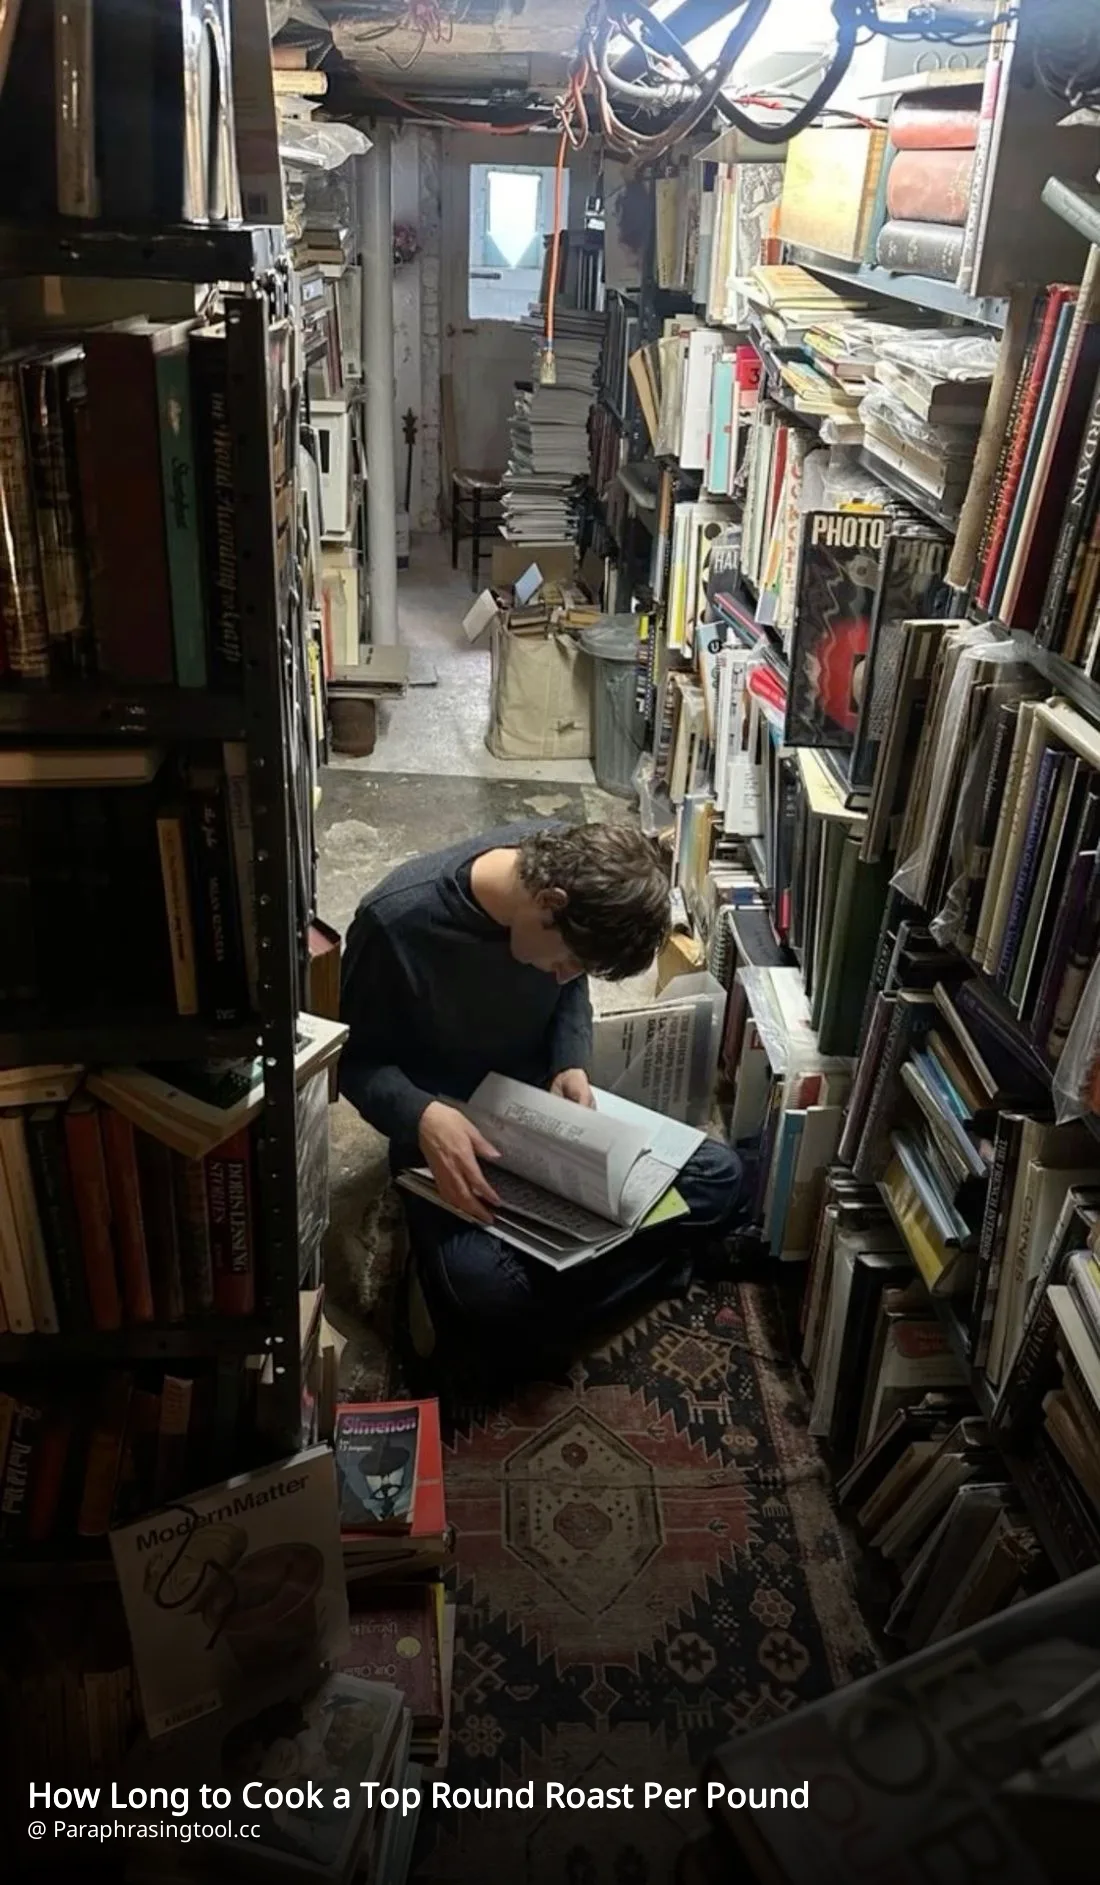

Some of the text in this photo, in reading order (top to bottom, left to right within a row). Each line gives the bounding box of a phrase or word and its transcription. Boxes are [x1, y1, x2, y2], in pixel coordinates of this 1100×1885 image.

[748, 368, 760, 384] 3
[811, 514, 885, 549] PHOTO
[892, 538, 948, 575] PHO
[208, 1160, 227, 1225] STORIES
[229, 1211, 249, 1273] LESSING
[341, 1415, 417, 1435] Simenon
[136, 1474, 310, 1551] ModernMatter
